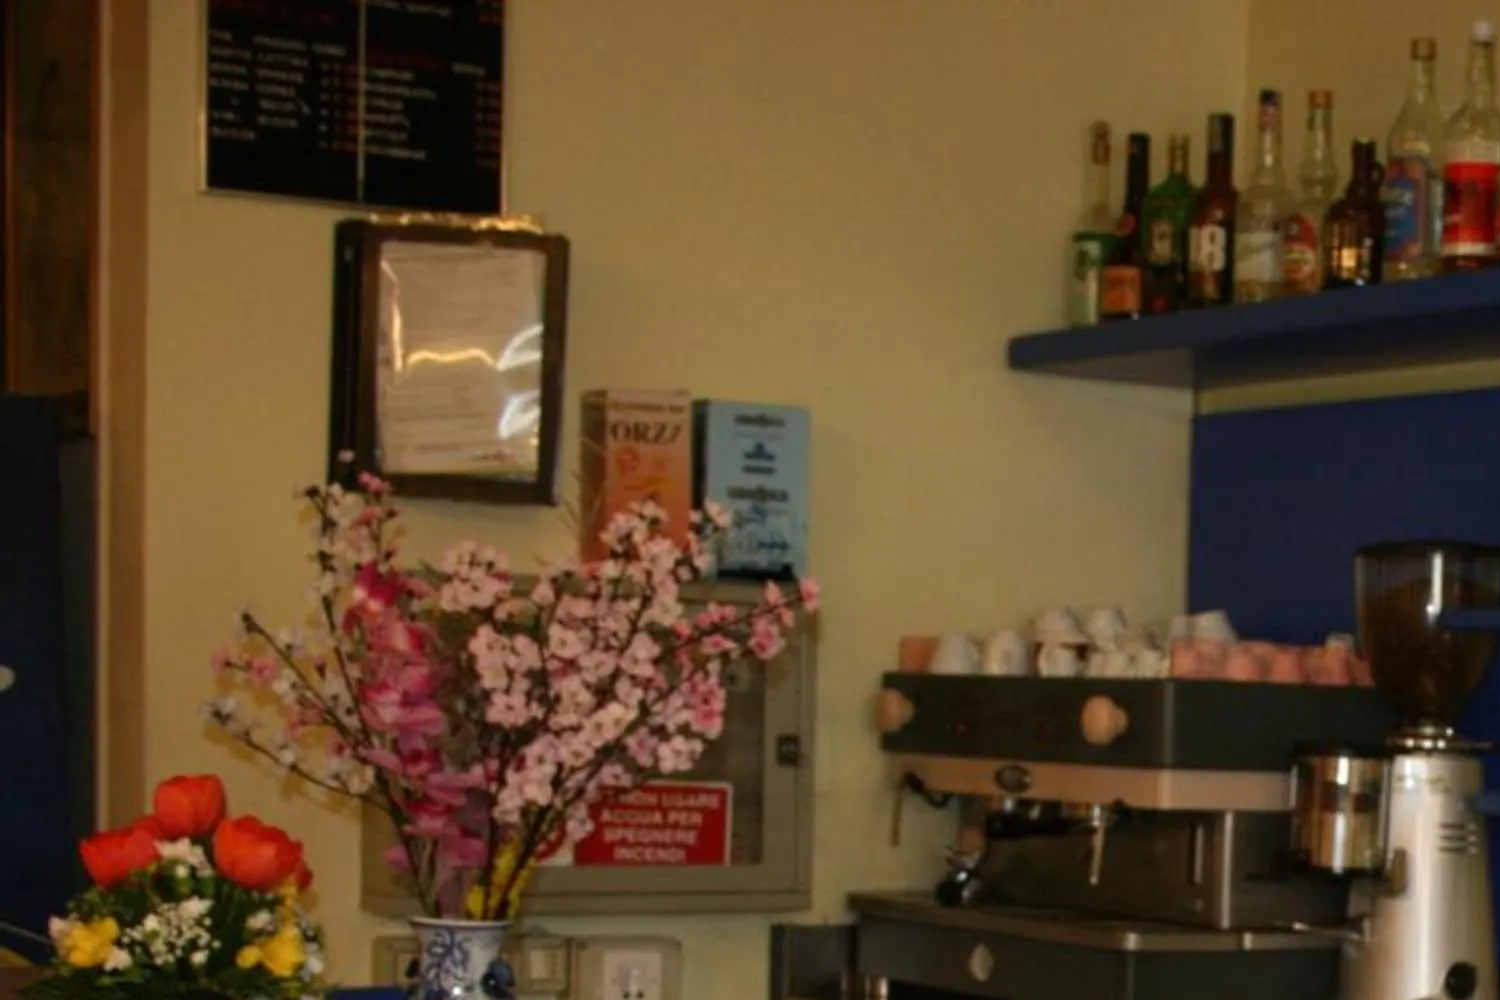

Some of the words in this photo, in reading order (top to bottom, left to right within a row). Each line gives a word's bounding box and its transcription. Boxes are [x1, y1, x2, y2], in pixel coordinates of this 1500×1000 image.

[661, 792, 720, 810] USARE
[600, 807, 664, 824] ACQUA
[667, 810, 704, 827] PER
[602, 826, 699, 845] SPEGNERE
[613, 846, 688, 863] INCENDI
